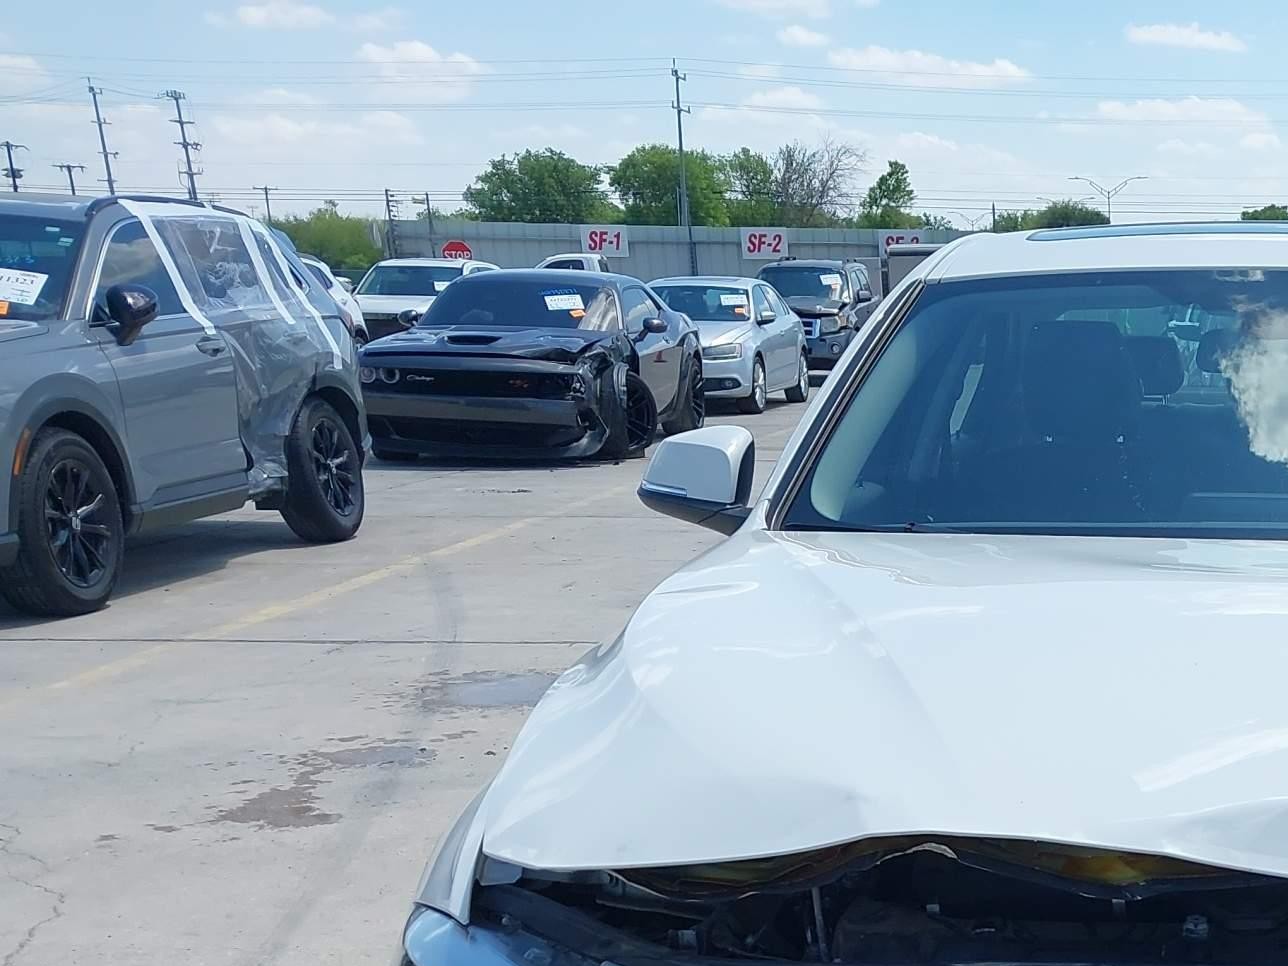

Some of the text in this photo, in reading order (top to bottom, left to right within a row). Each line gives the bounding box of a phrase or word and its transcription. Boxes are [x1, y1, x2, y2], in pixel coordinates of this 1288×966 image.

[588, 230, 621, 251] SF-1
[747, 233, 782, 253] SF-2
[444, 250, 471, 259] STOP
